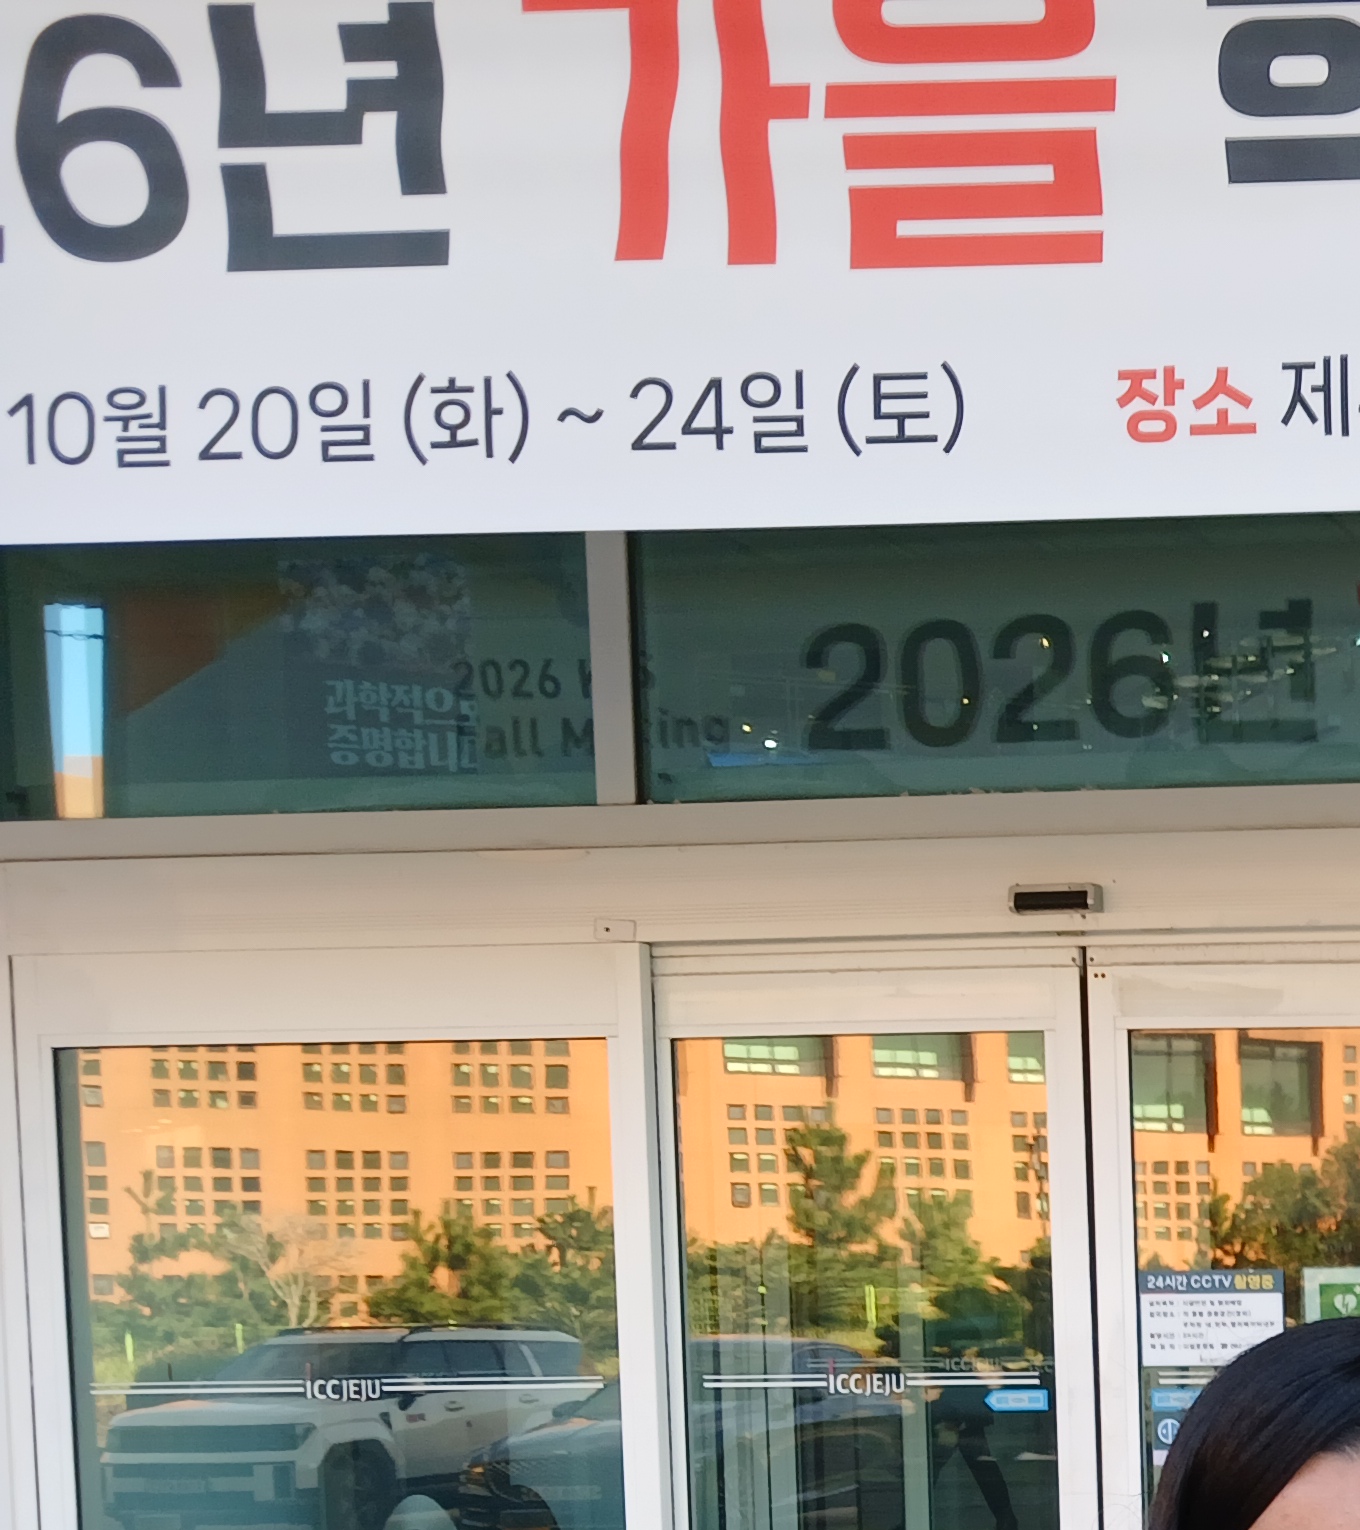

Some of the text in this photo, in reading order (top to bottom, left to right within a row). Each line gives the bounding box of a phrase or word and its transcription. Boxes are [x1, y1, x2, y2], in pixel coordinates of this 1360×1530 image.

[0, 0, 450, 272] 6년
[522, 0, 1117, 269] 가을
[8, 385, 171, 469] 10월
[198, 379, 375, 463] 20일
[403, 371, 529, 466] (화)
[629, 369, 809, 455] 24일
[837, 361, 964, 457] (토)
[1117, 367, 1257, 443] 장소
[1147, 1274, 1189, 1290] 24시간
[1190, 1274, 1232, 1289] CCTV
